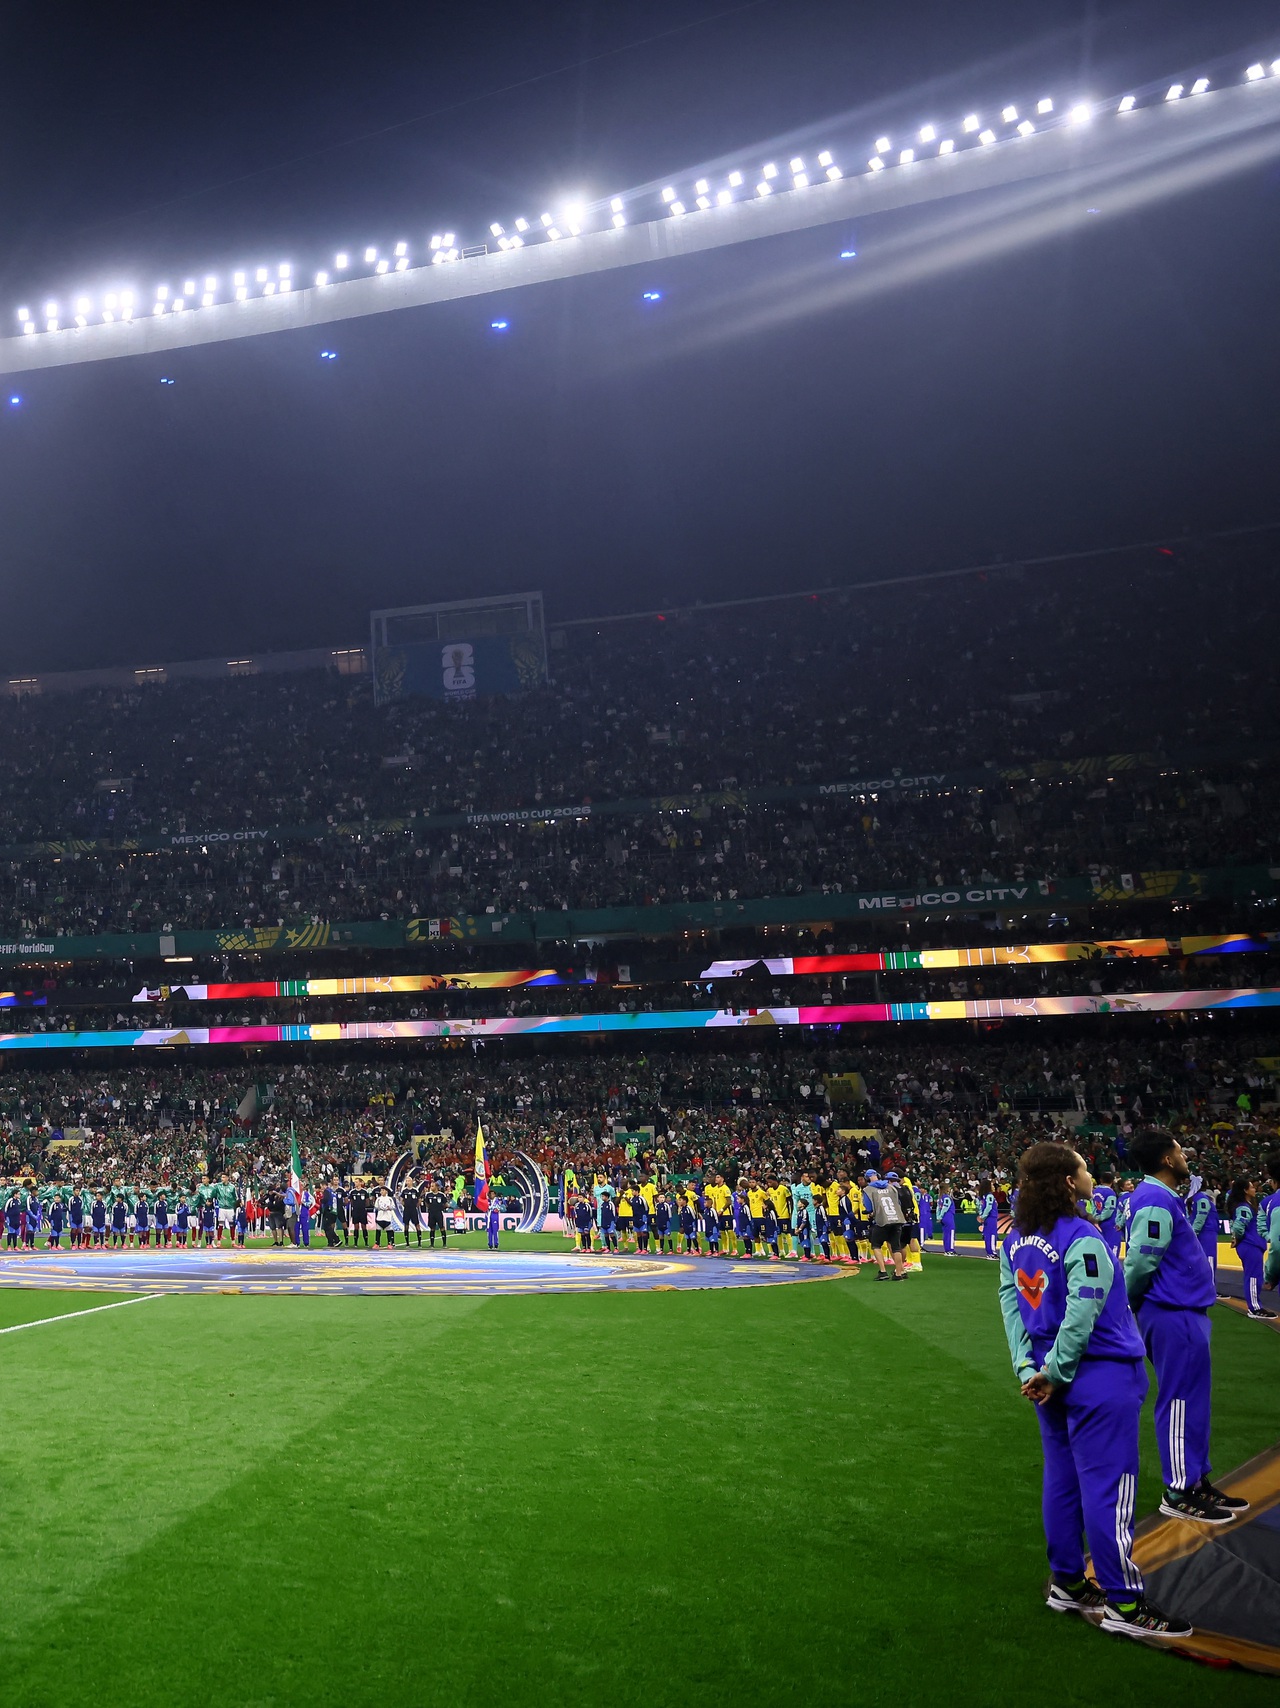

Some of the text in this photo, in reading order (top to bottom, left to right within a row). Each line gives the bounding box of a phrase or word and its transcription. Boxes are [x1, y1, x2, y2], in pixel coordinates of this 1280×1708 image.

[819, 774, 946, 794] MEXICO CITY
[466, 806, 592, 823] FIFA WORLD CUP 2026
[171, 830, 269, 844] MEXICO CITY
[858, 887, 1029, 909] MEICO CITY
